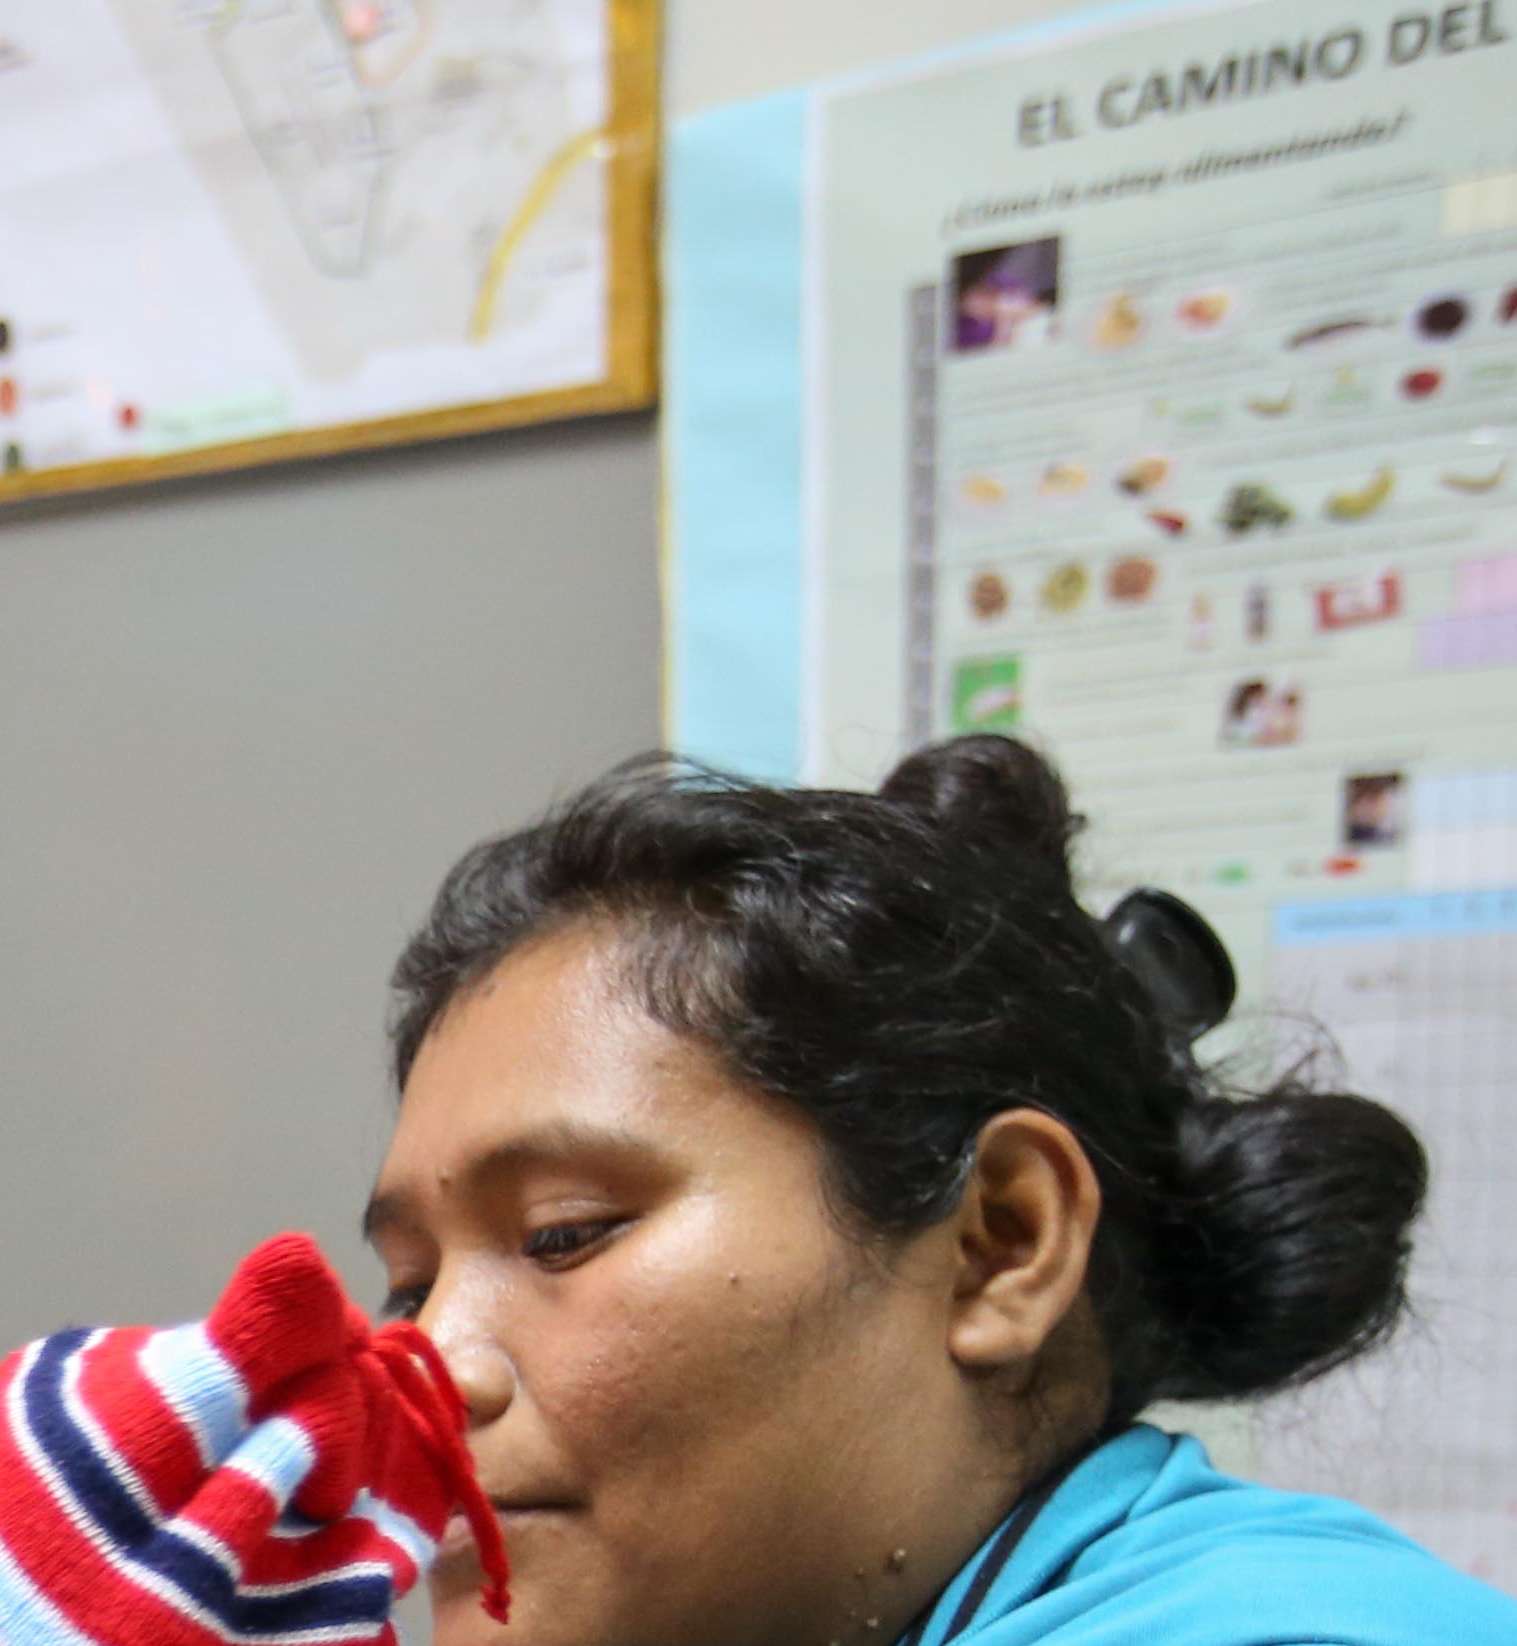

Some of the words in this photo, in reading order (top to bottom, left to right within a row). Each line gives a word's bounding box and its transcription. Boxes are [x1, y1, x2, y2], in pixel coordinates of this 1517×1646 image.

[1017, 86, 1080, 147] EL
[1096, 25, 1363, 129] CAMINO
[1385, 0, 1509, 66] DEL
